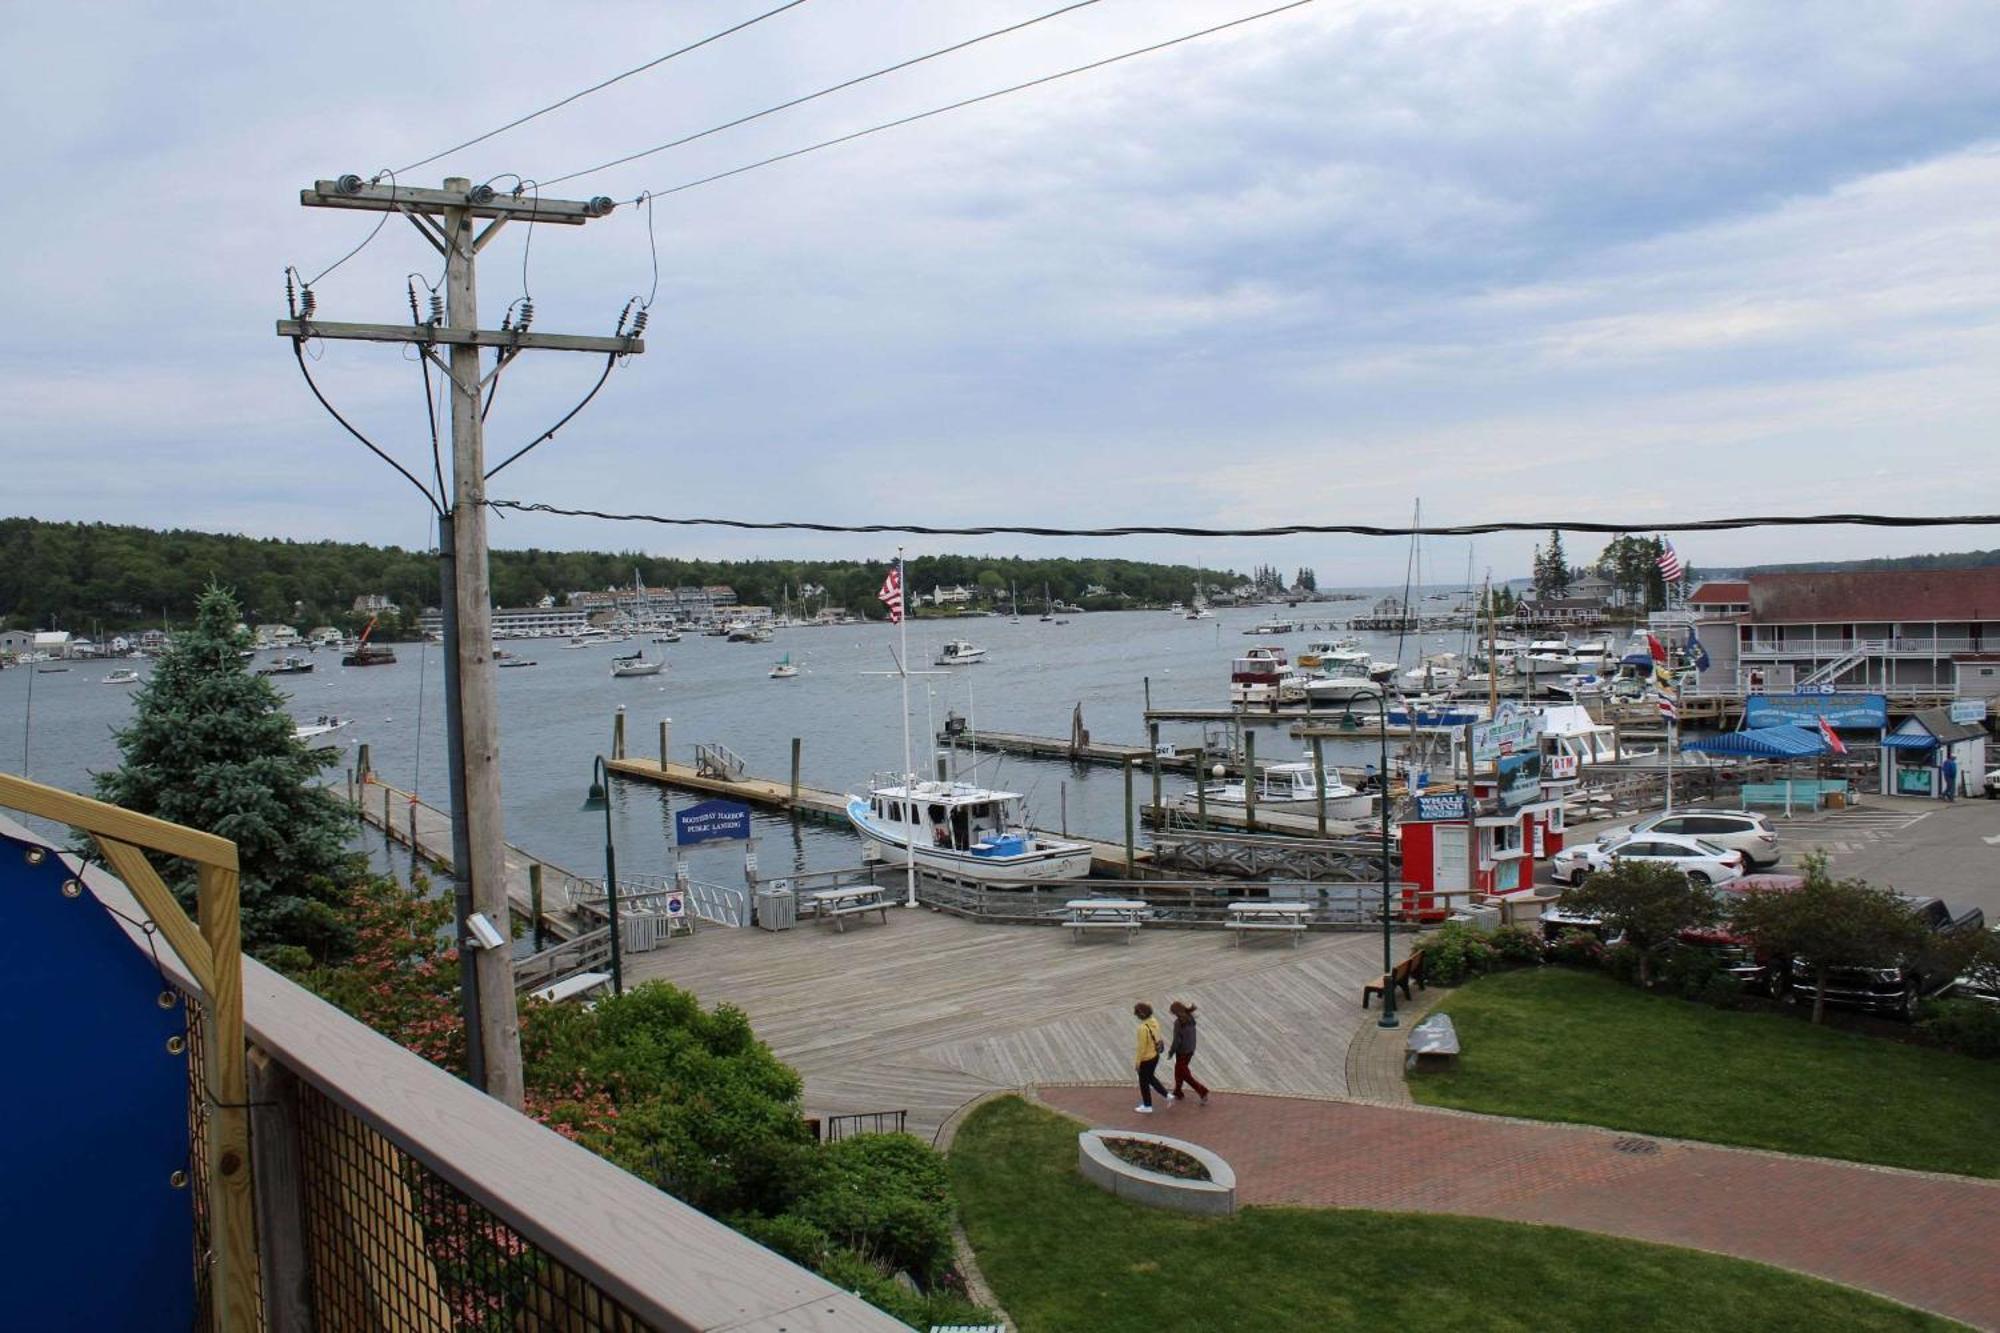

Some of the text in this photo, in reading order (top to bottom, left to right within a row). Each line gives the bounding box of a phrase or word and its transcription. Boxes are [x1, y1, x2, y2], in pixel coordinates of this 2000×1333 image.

[1797, 684, 1836, 694] PIER 8
[1554, 756, 1574, 769] ATM
[1420, 796, 1465, 804] WHALE
[1421, 803, 1464, 811] WATCH
[681, 811, 745, 824] BOOTHBAY HARBOR
[687, 821, 741, 833] PUBLIC LANDING
